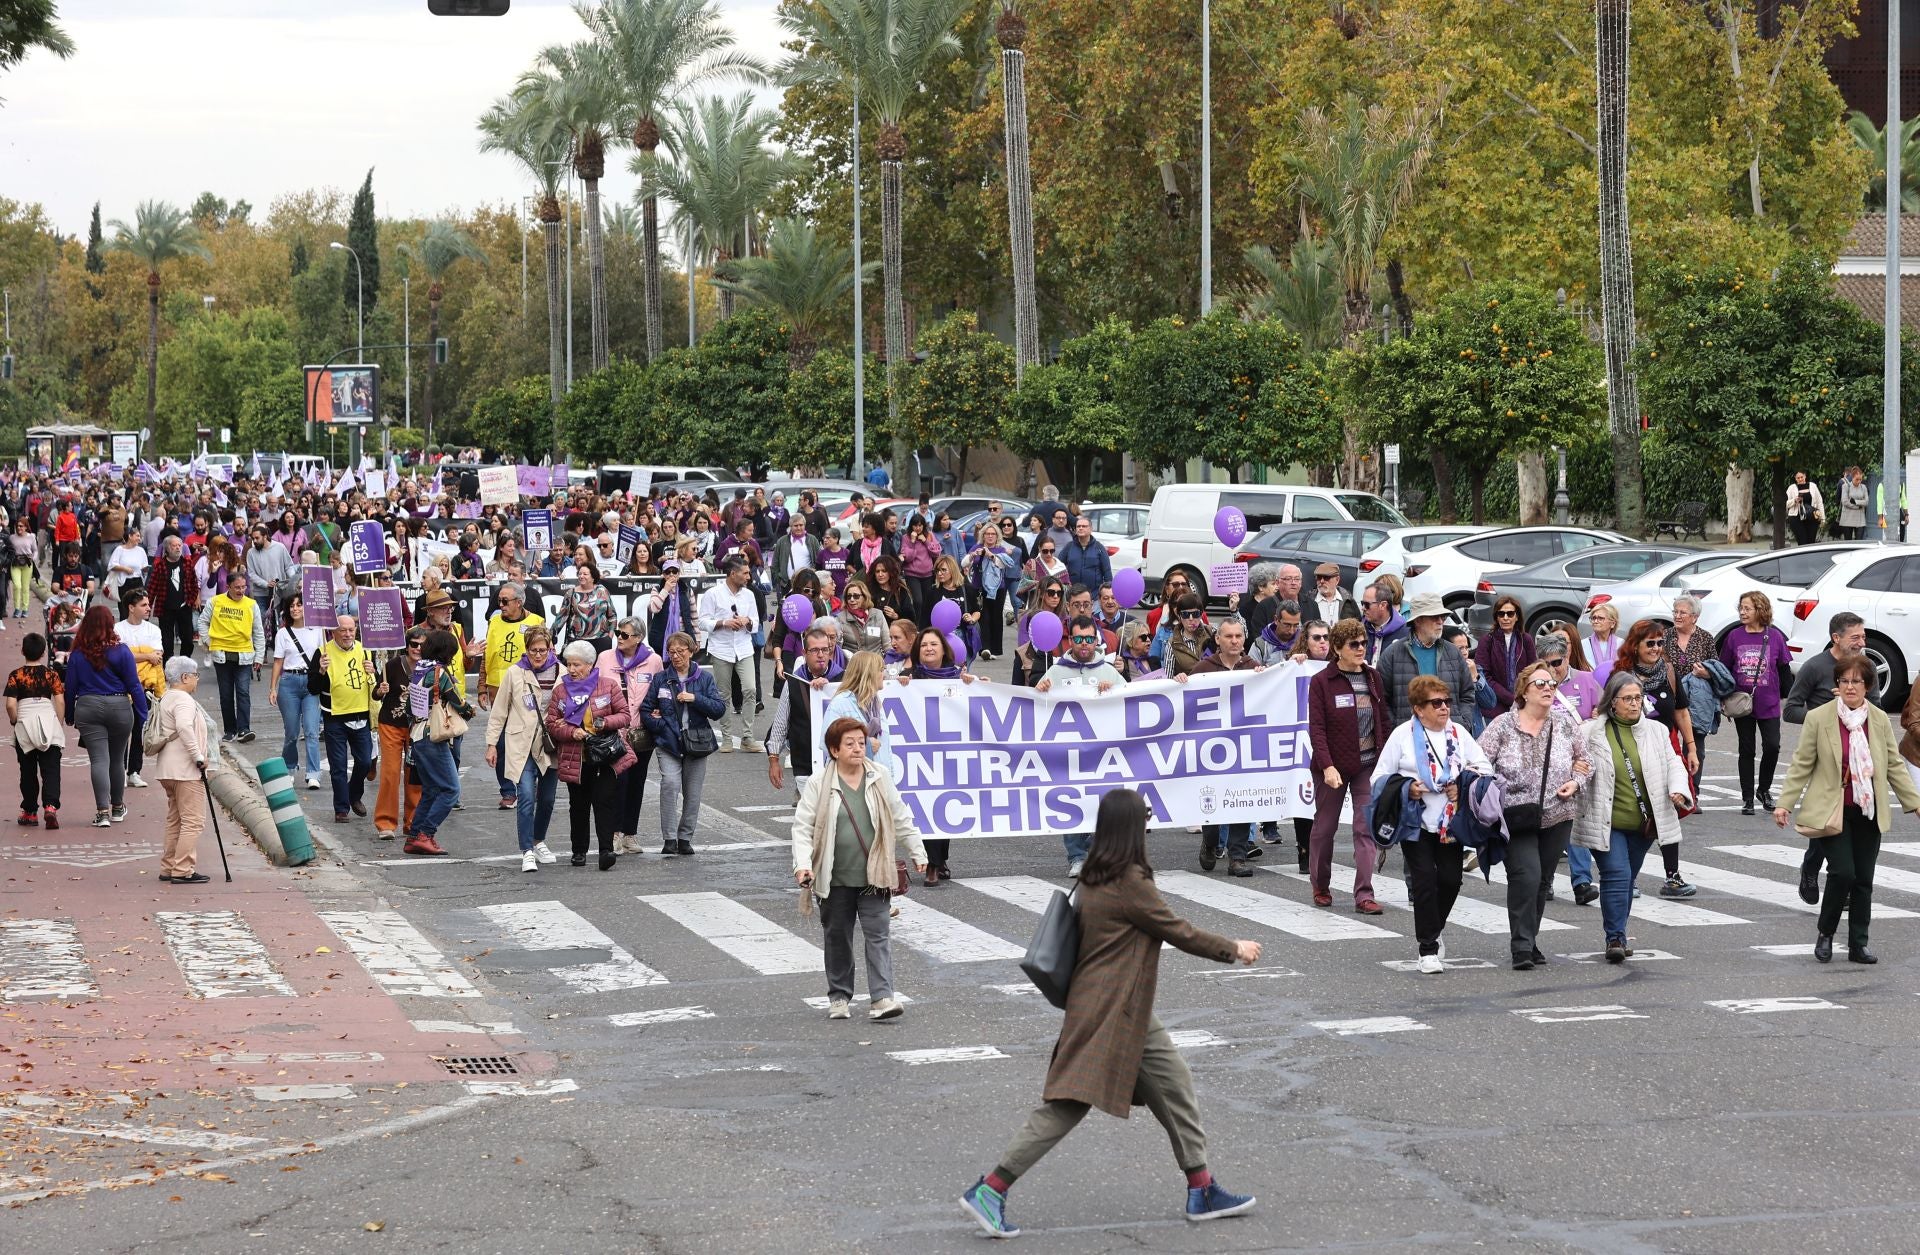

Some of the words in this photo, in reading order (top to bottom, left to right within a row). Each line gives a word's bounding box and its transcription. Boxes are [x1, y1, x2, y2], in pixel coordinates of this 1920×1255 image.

[352, 525, 364, 533] SE
[354, 543, 368, 552] CA
[355, 549, 369, 560] BÓ
[822, 696, 1097, 744] ALMA
[1124, 684, 1267, 738] DEL
[893, 750, 1051, 787] NTRA
[1068, 747, 1134, 781] LA
[1632, 780, 1641, 797] YOUNG
[901, 782, 1172, 835] ACHISA
[1223, 798, 1254, 808] Palma
[1257, 797, 1273, 807] del
